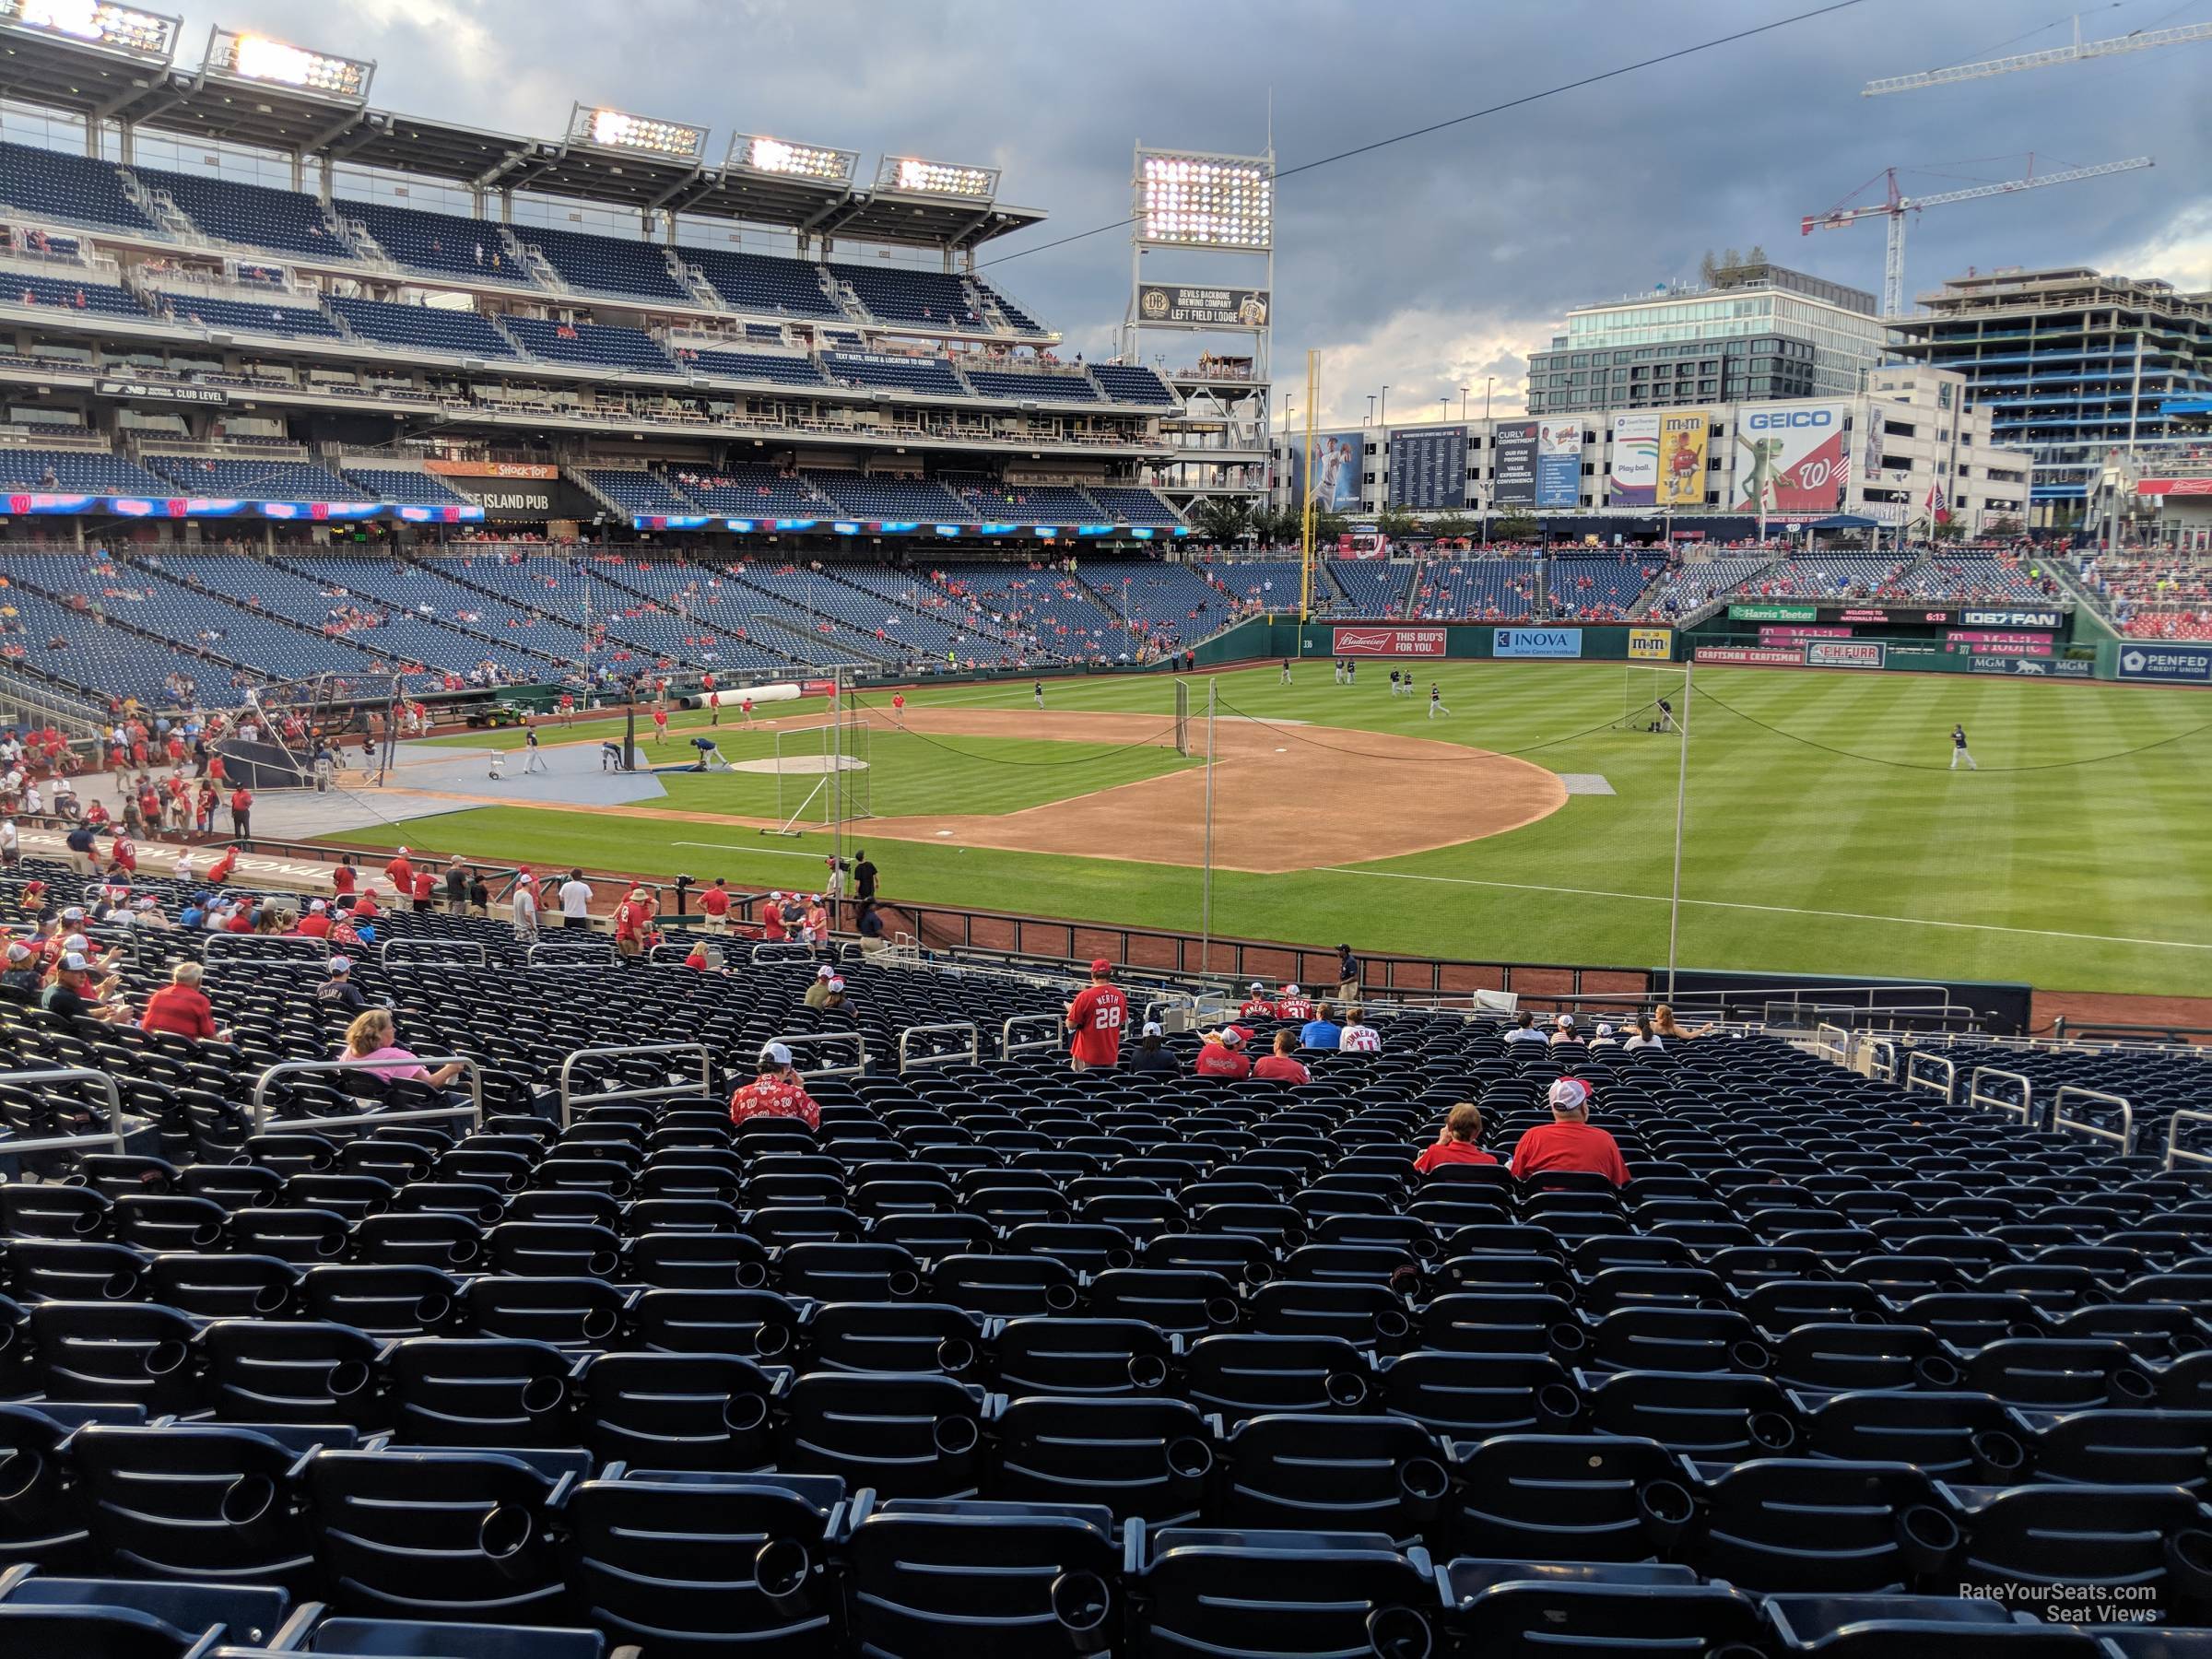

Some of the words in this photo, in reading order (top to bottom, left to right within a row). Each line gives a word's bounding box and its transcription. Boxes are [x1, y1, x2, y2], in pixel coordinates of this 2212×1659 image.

[1180, 289, 1200, 299] DEVILS
[1201, 291, 1230, 300] BACKBONE
[1148, 294, 1163, 309] DB
[1178, 298, 1204, 307] BREWING
[1206, 300, 1232, 308] COMPANY
[1171, 309, 1189, 320] LEFT
[1192, 310, 1212, 321] FIELD
[1214, 311, 1238, 323] LODGE
[177, 389, 197, 399] CLUB
[199, 391, 223, 401] LEVEL
[1750, 410, 1832, 429] GEICO
[1499, 430, 1524, 439] CURLY
[498, 464, 528, 476] SHOCK
[530, 465, 547, 477] TOP
[1618, 465, 1635, 473] Play
[483, 494, 524, 509] ISLAND
[525, 495, 549, 510] PUB
[1745, 609, 1777, 618] Harris
[1779, 610, 1813, 619] Teeter
[1926, 612, 1947, 621] 6:13
[2011, 614, 2055, 625] FAN
[1342, 636, 1384, 645] Budweiser
[1395, 632, 1416, 641] THIS
[1418, 632, 1443, 641] BUD'S
[1515, 633, 1567, 646] INOVA
[1395, 642, 1412, 652] FOR
[1415, 643, 1434, 653] YOU.
[1983, 634, 2050, 653] Mobile
[1698, 651, 1746, 660] CRAFTSMAN
[1750, 653, 1801, 662] CRAFTSMAN
[2147, 654, 2206, 666] PENFED
[1974, 658, 2006, 667] MGM
[2055, 662, 2088, 671] MGM
[1096, 994, 1119, 1006] WERTH
[1281, 1001, 1311, 1010] SCHERZER
[1095, 1006, 1121, 1030] 28
[1288, 1007, 1305, 1018] 31
[1357, 1040, 1373, 1051] 11
